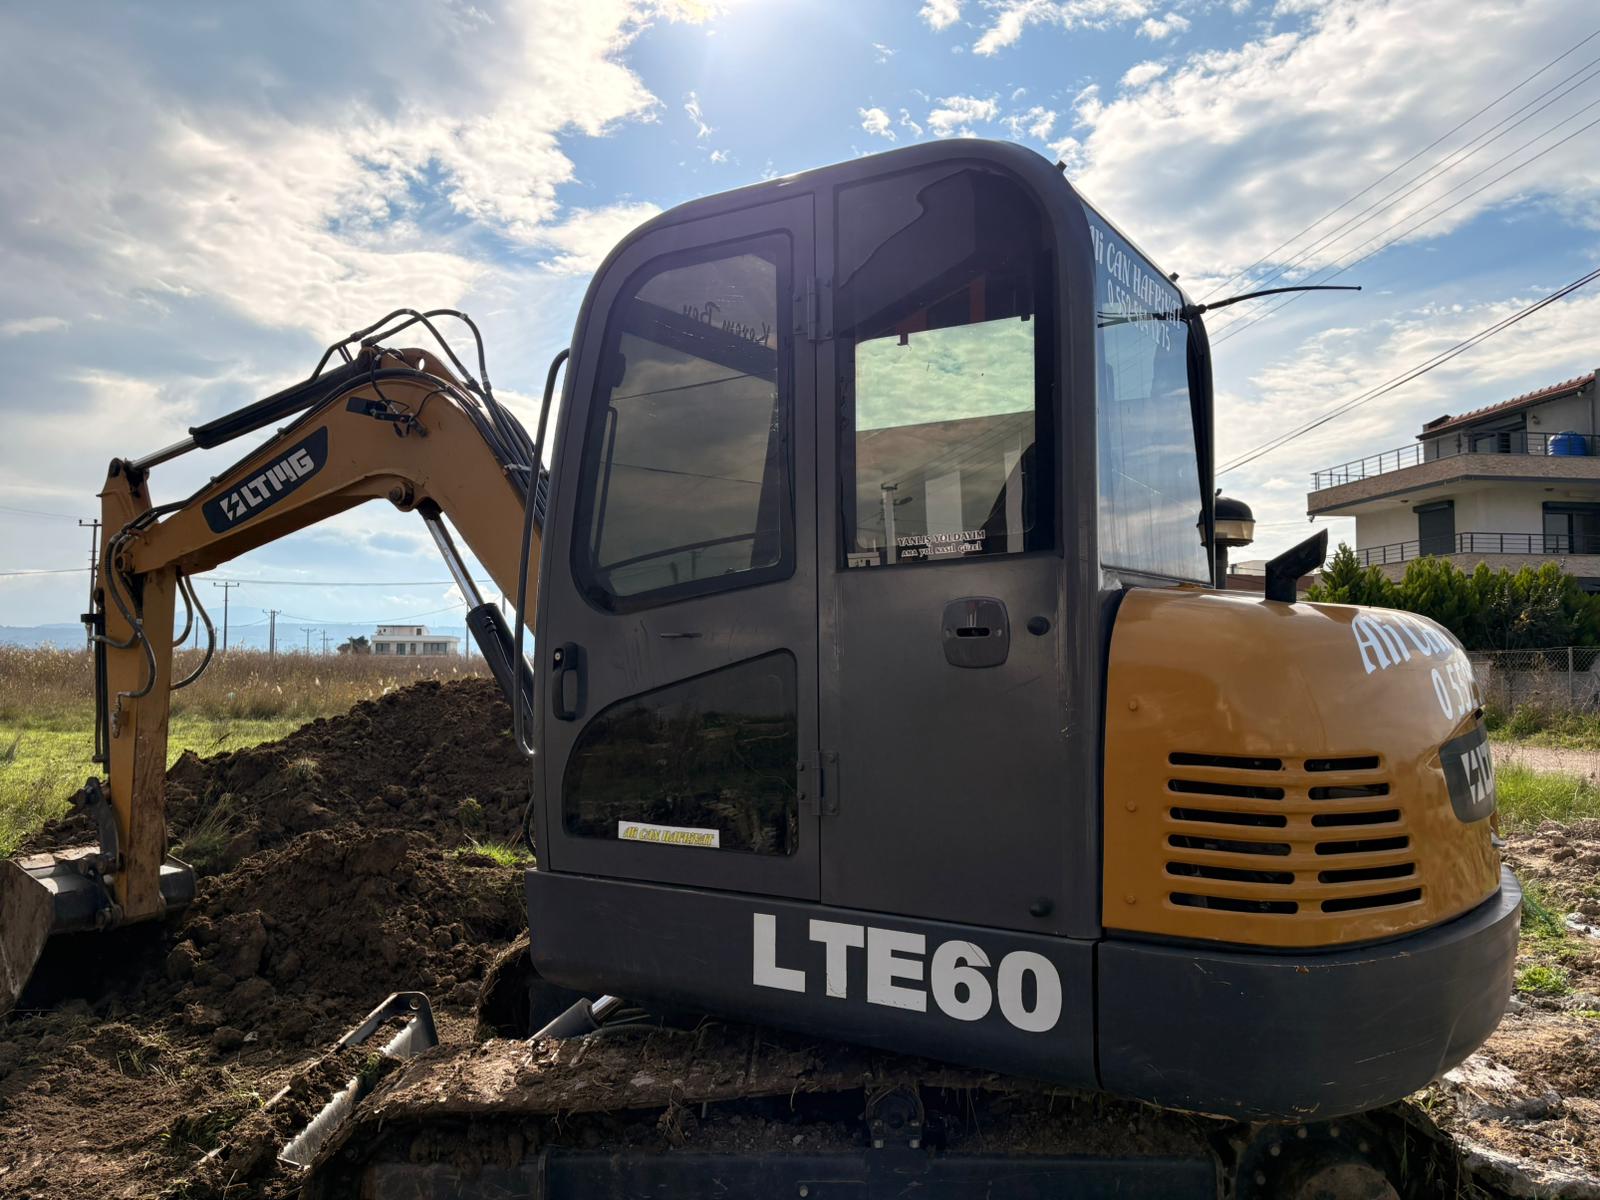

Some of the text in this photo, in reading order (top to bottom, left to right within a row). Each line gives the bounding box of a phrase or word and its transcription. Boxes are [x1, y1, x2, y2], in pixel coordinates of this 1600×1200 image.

[1106, 243, 1130, 287] CAN
[1107, 279, 1114, 307] 0
[1352, 613, 1411, 674] Ali
[1431, 668, 1454, 721] 0
[753, 912, 1062, 1022] LTE60
